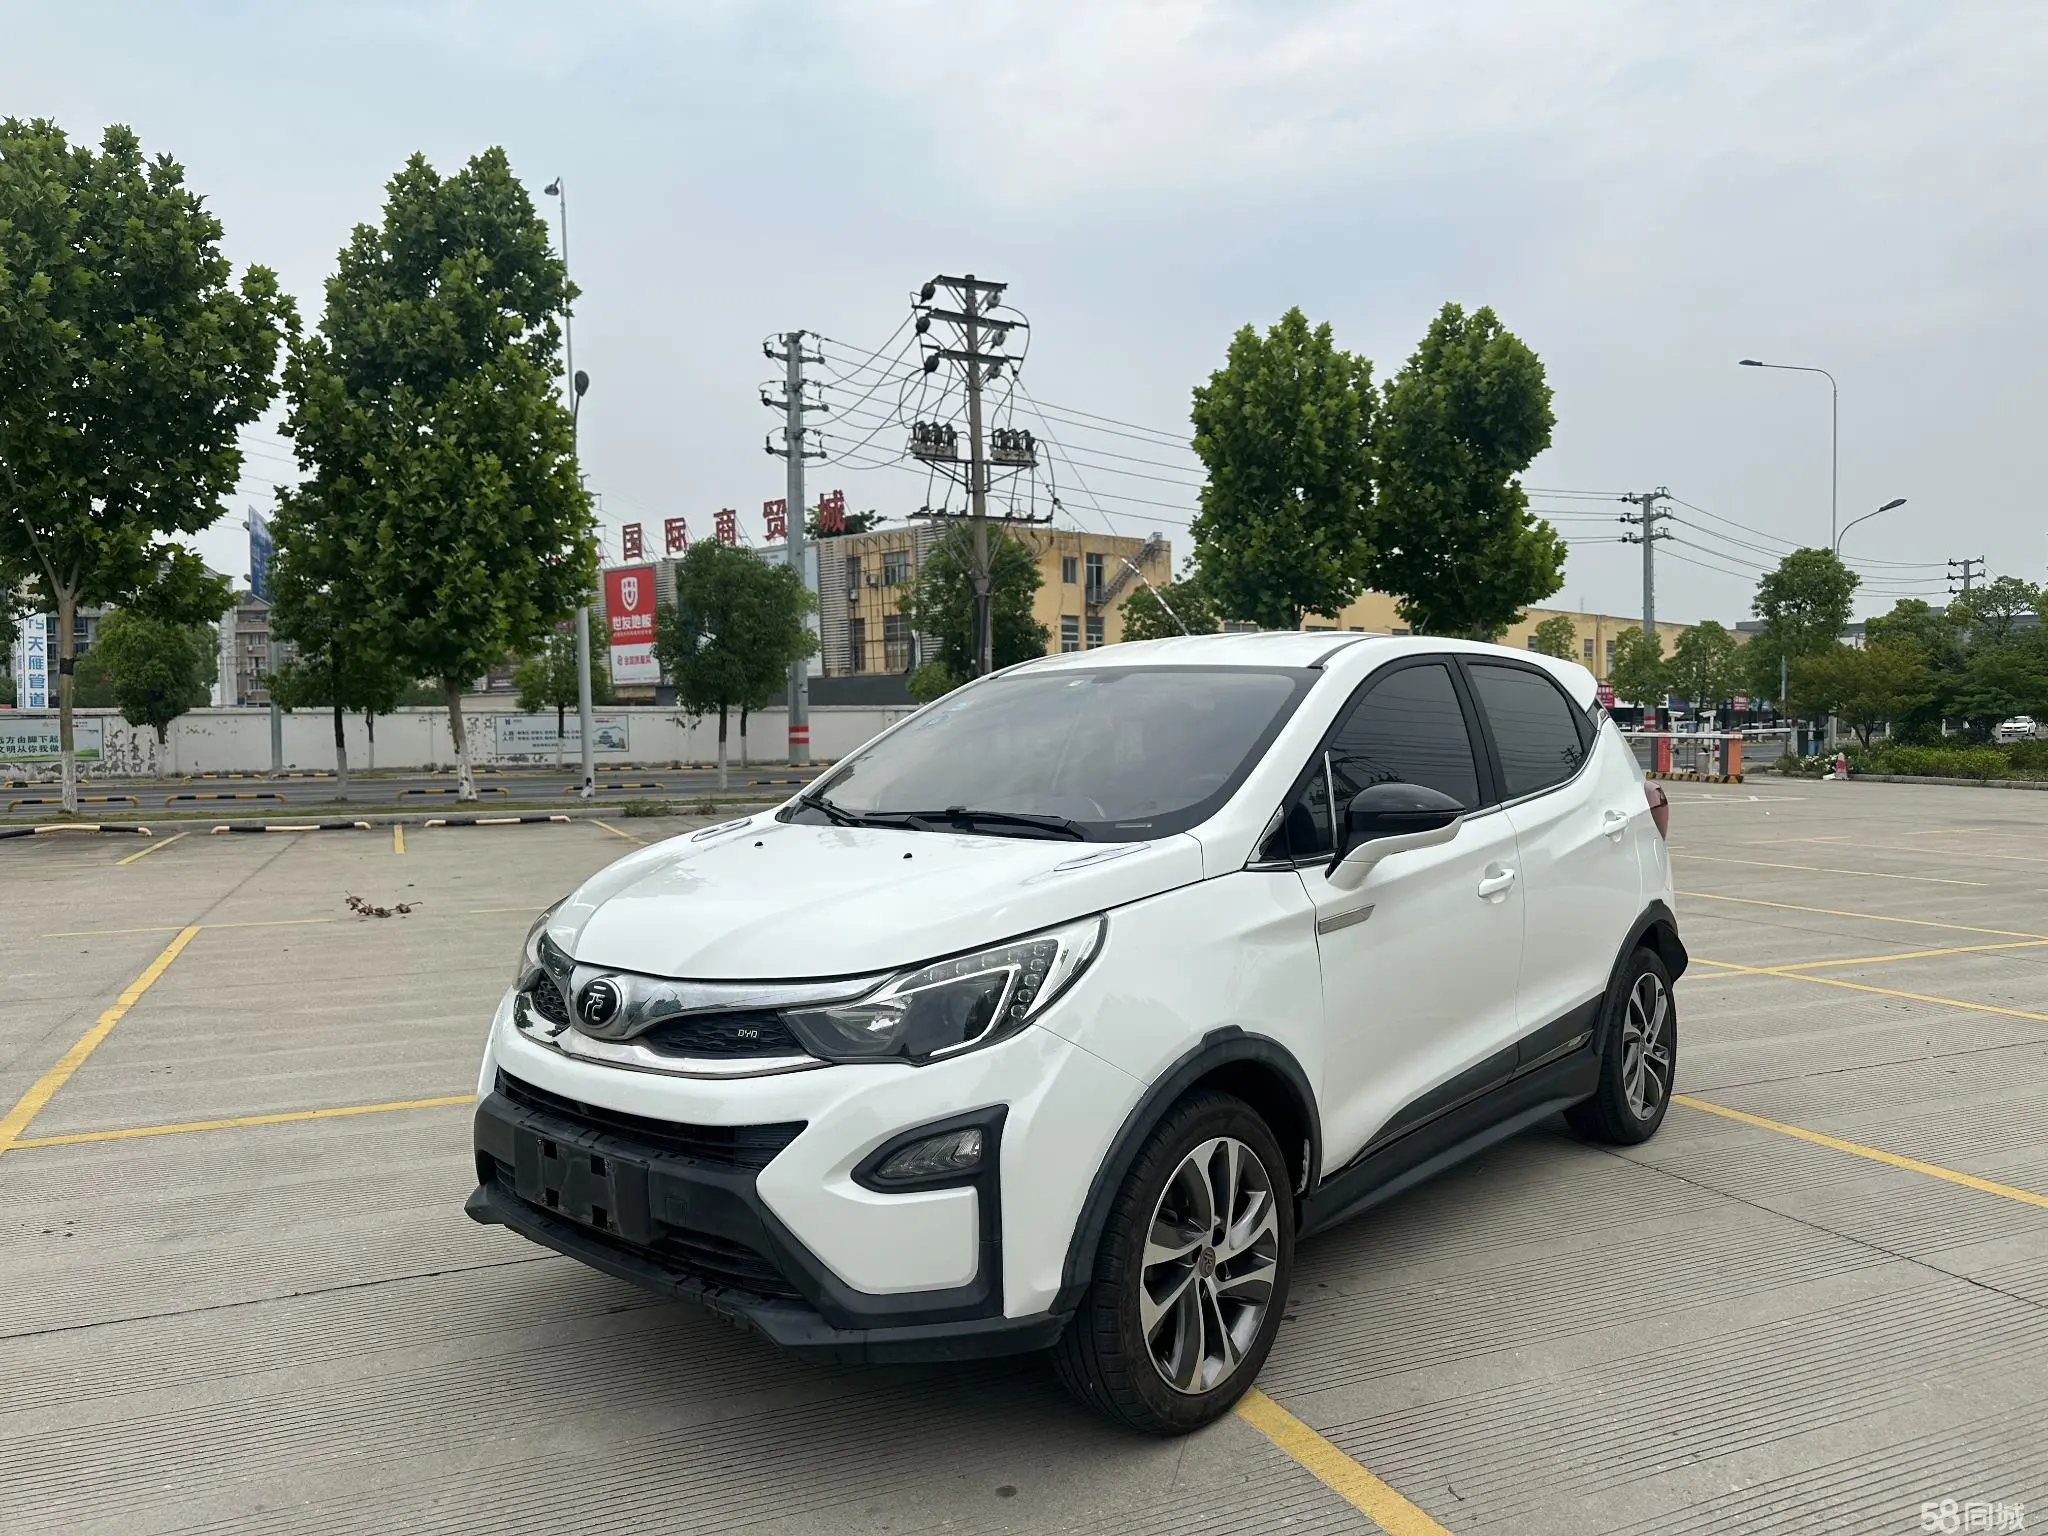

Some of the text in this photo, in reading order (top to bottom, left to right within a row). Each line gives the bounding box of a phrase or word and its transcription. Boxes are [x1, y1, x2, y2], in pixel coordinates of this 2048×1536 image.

[622, 490, 845, 560] 国际商贸城
